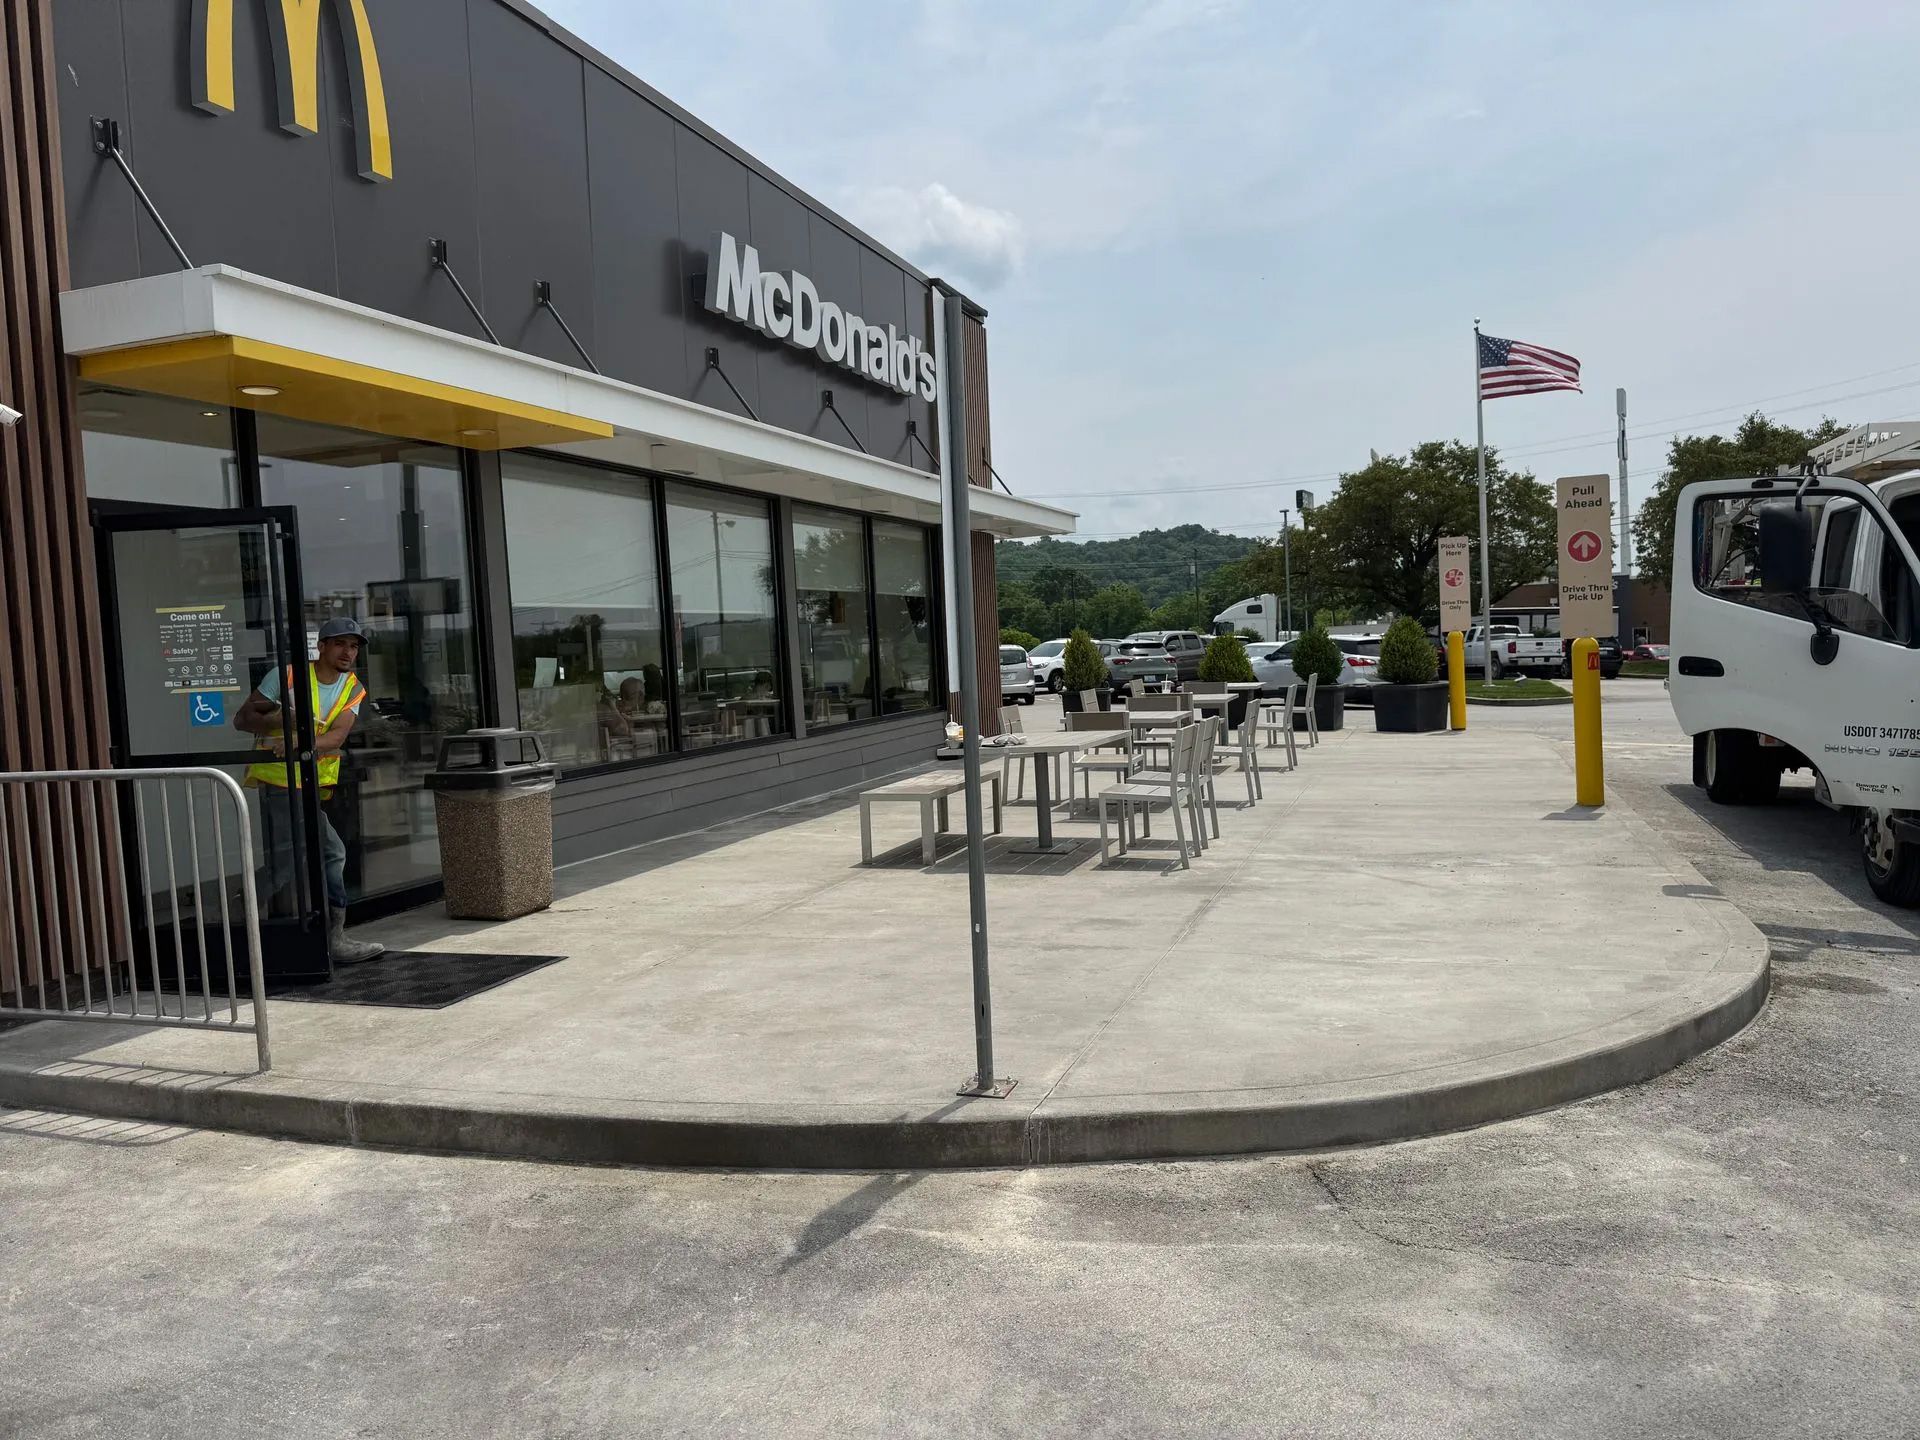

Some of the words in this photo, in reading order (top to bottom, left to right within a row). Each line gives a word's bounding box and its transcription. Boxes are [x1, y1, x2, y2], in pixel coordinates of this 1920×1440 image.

[712, 230, 937, 403] McDonald's
[1572, 485, 1595, 496] Pull
[1564, 497, 1602, 509] Ahead
[1562, 585, 1586, 593] Drive
[1588, 584, 1609, 592] Thru
[1568, 593, 1589, 601] Pick
[1590, 593, 1604, 601] Up
[170, 613, 197, 622] Come
[198, 612, 212, 620] on
[212, 611, 221, 619] in
[1843, 725, 1878, 738] USDOT
